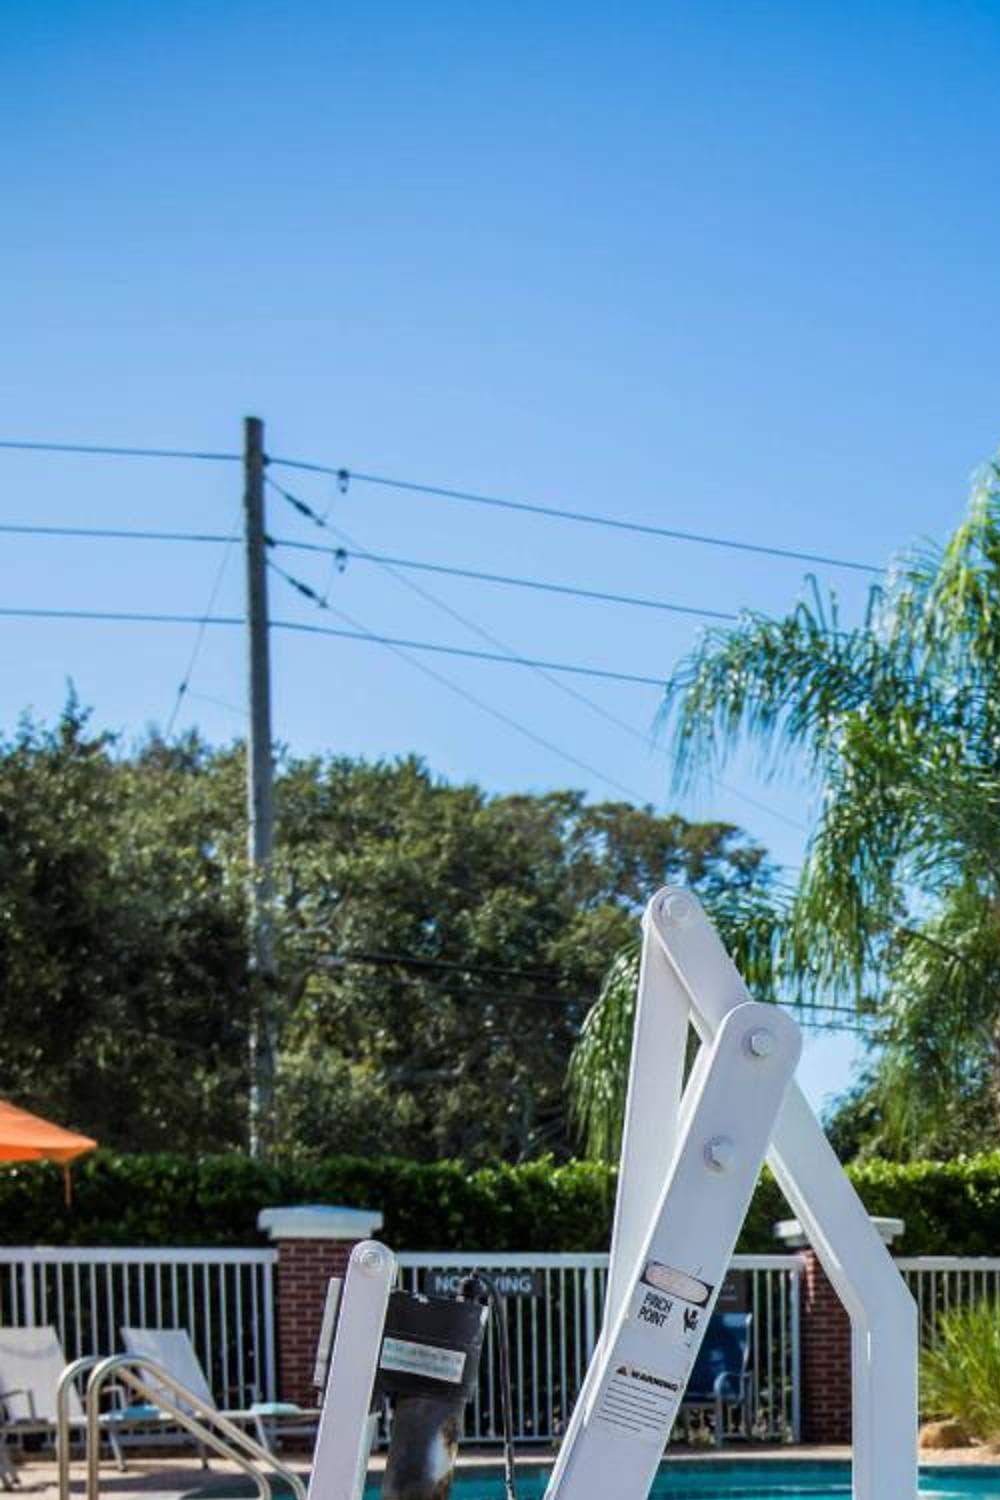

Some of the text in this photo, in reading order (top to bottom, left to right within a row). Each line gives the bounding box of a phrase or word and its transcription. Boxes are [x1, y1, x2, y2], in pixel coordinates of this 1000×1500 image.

[643, 1291, 673, 1313] PINCH
[637, 1305, 667, 1328] POINT
[631, 1368, 679, 1392] WARNING
